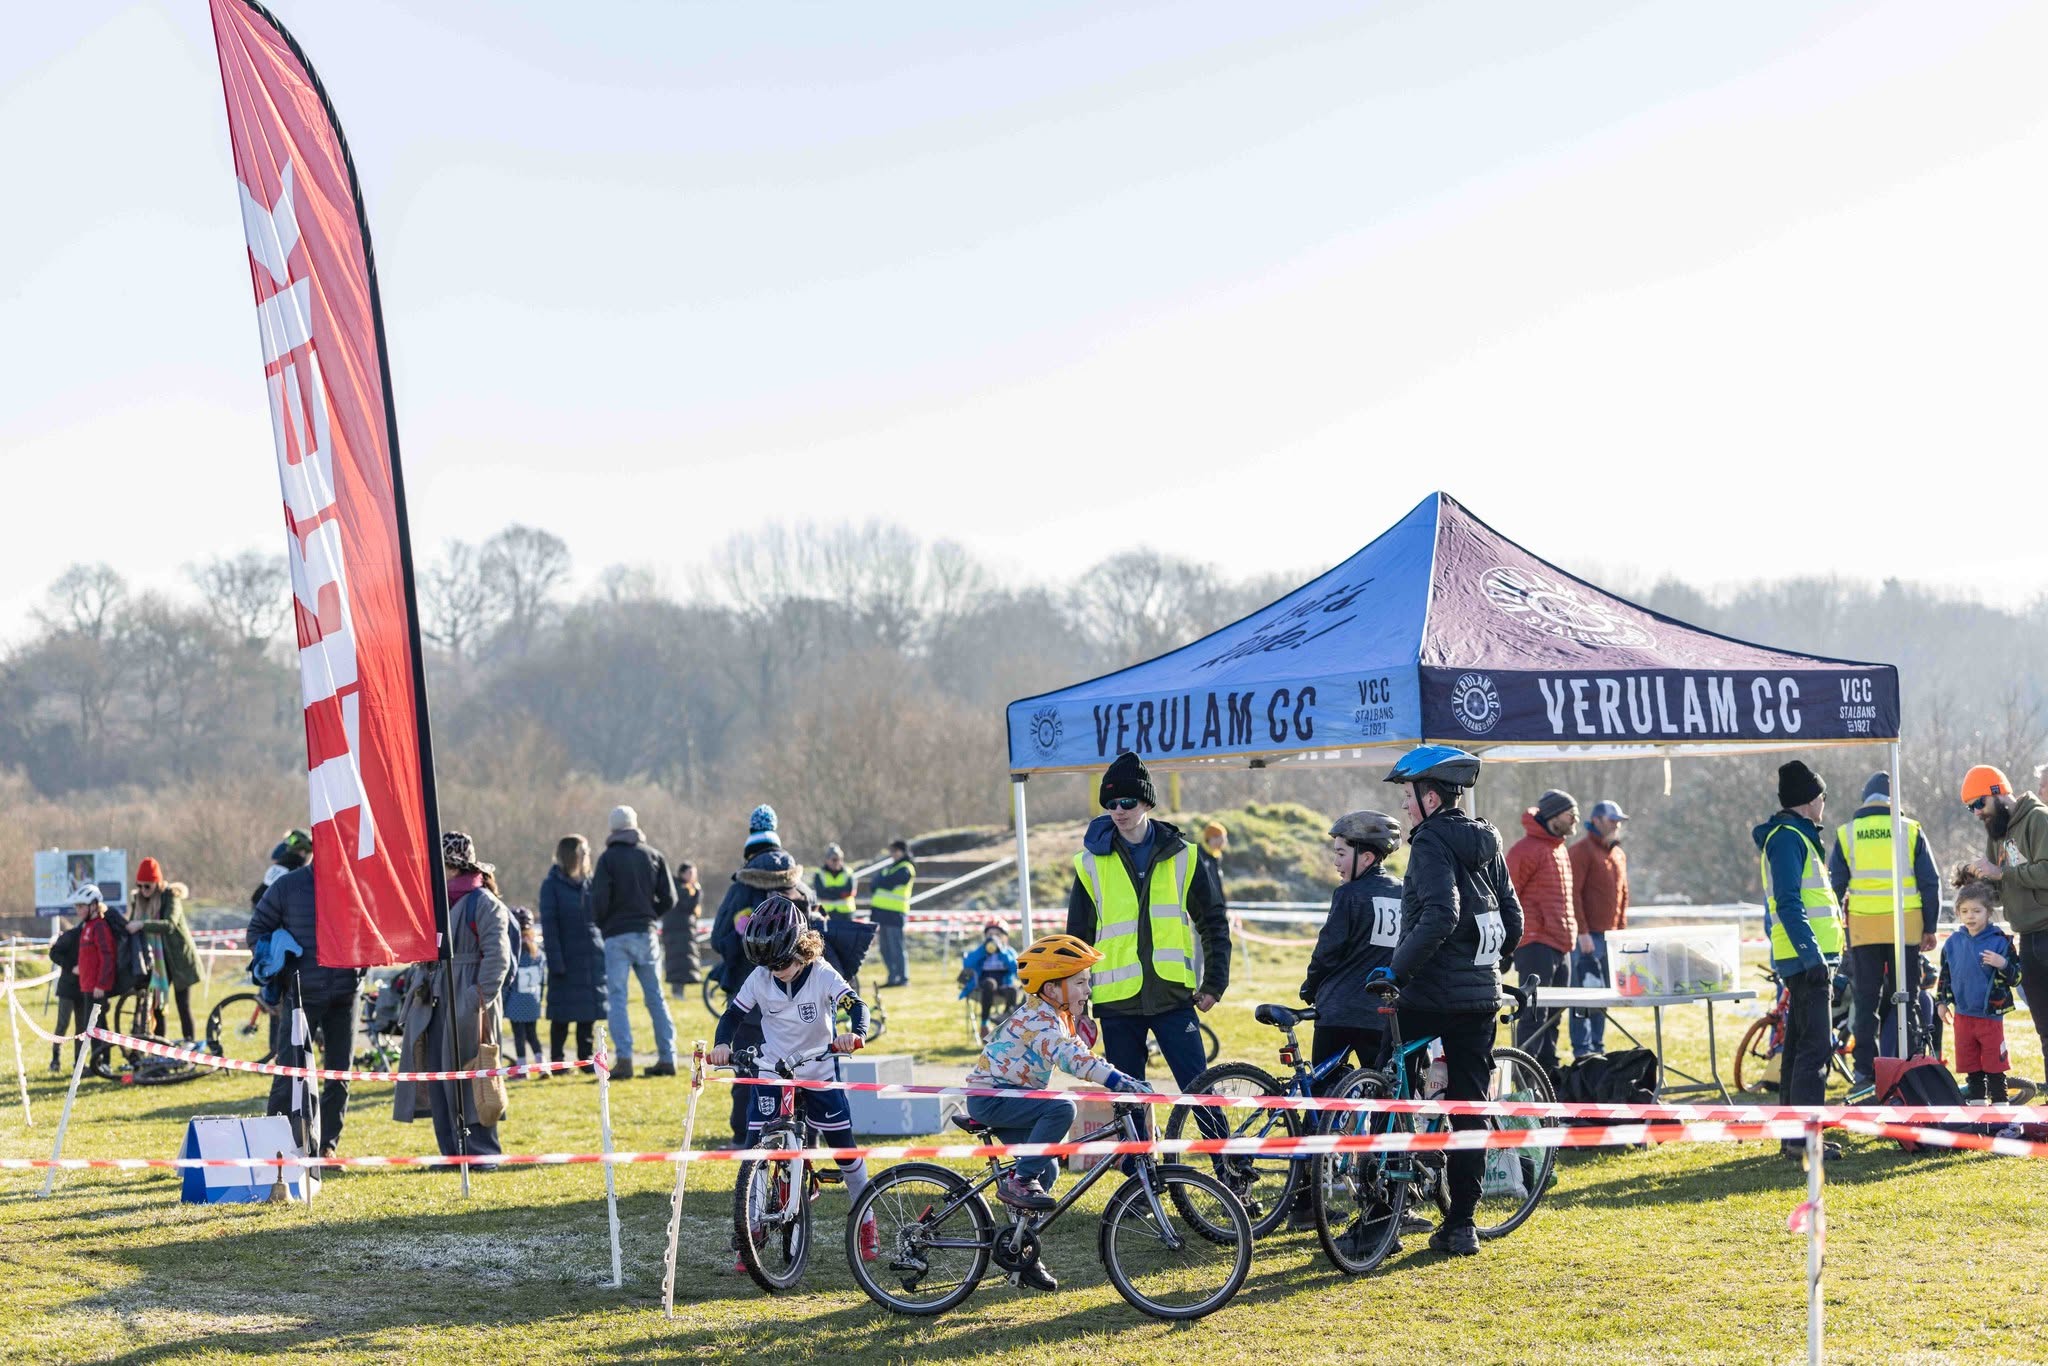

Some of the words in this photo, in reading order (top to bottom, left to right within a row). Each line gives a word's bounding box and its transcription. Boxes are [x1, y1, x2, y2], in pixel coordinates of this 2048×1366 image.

[1358, 677, 1390, 706] VCC
[1840, 677, 1872, 703] VCC
[1538, 676, 1738, 734] VERULAM
[1751, 676, 1801, 733] CC
[1093, 691, 1255, 757] VERULAM
[1267, 686, 1317, 743] CC
[1853, 719, 1871, 733] 1927
[1857, 828, 1892, 840] MARSHA
[901, 1100, 914, 1133] 3
